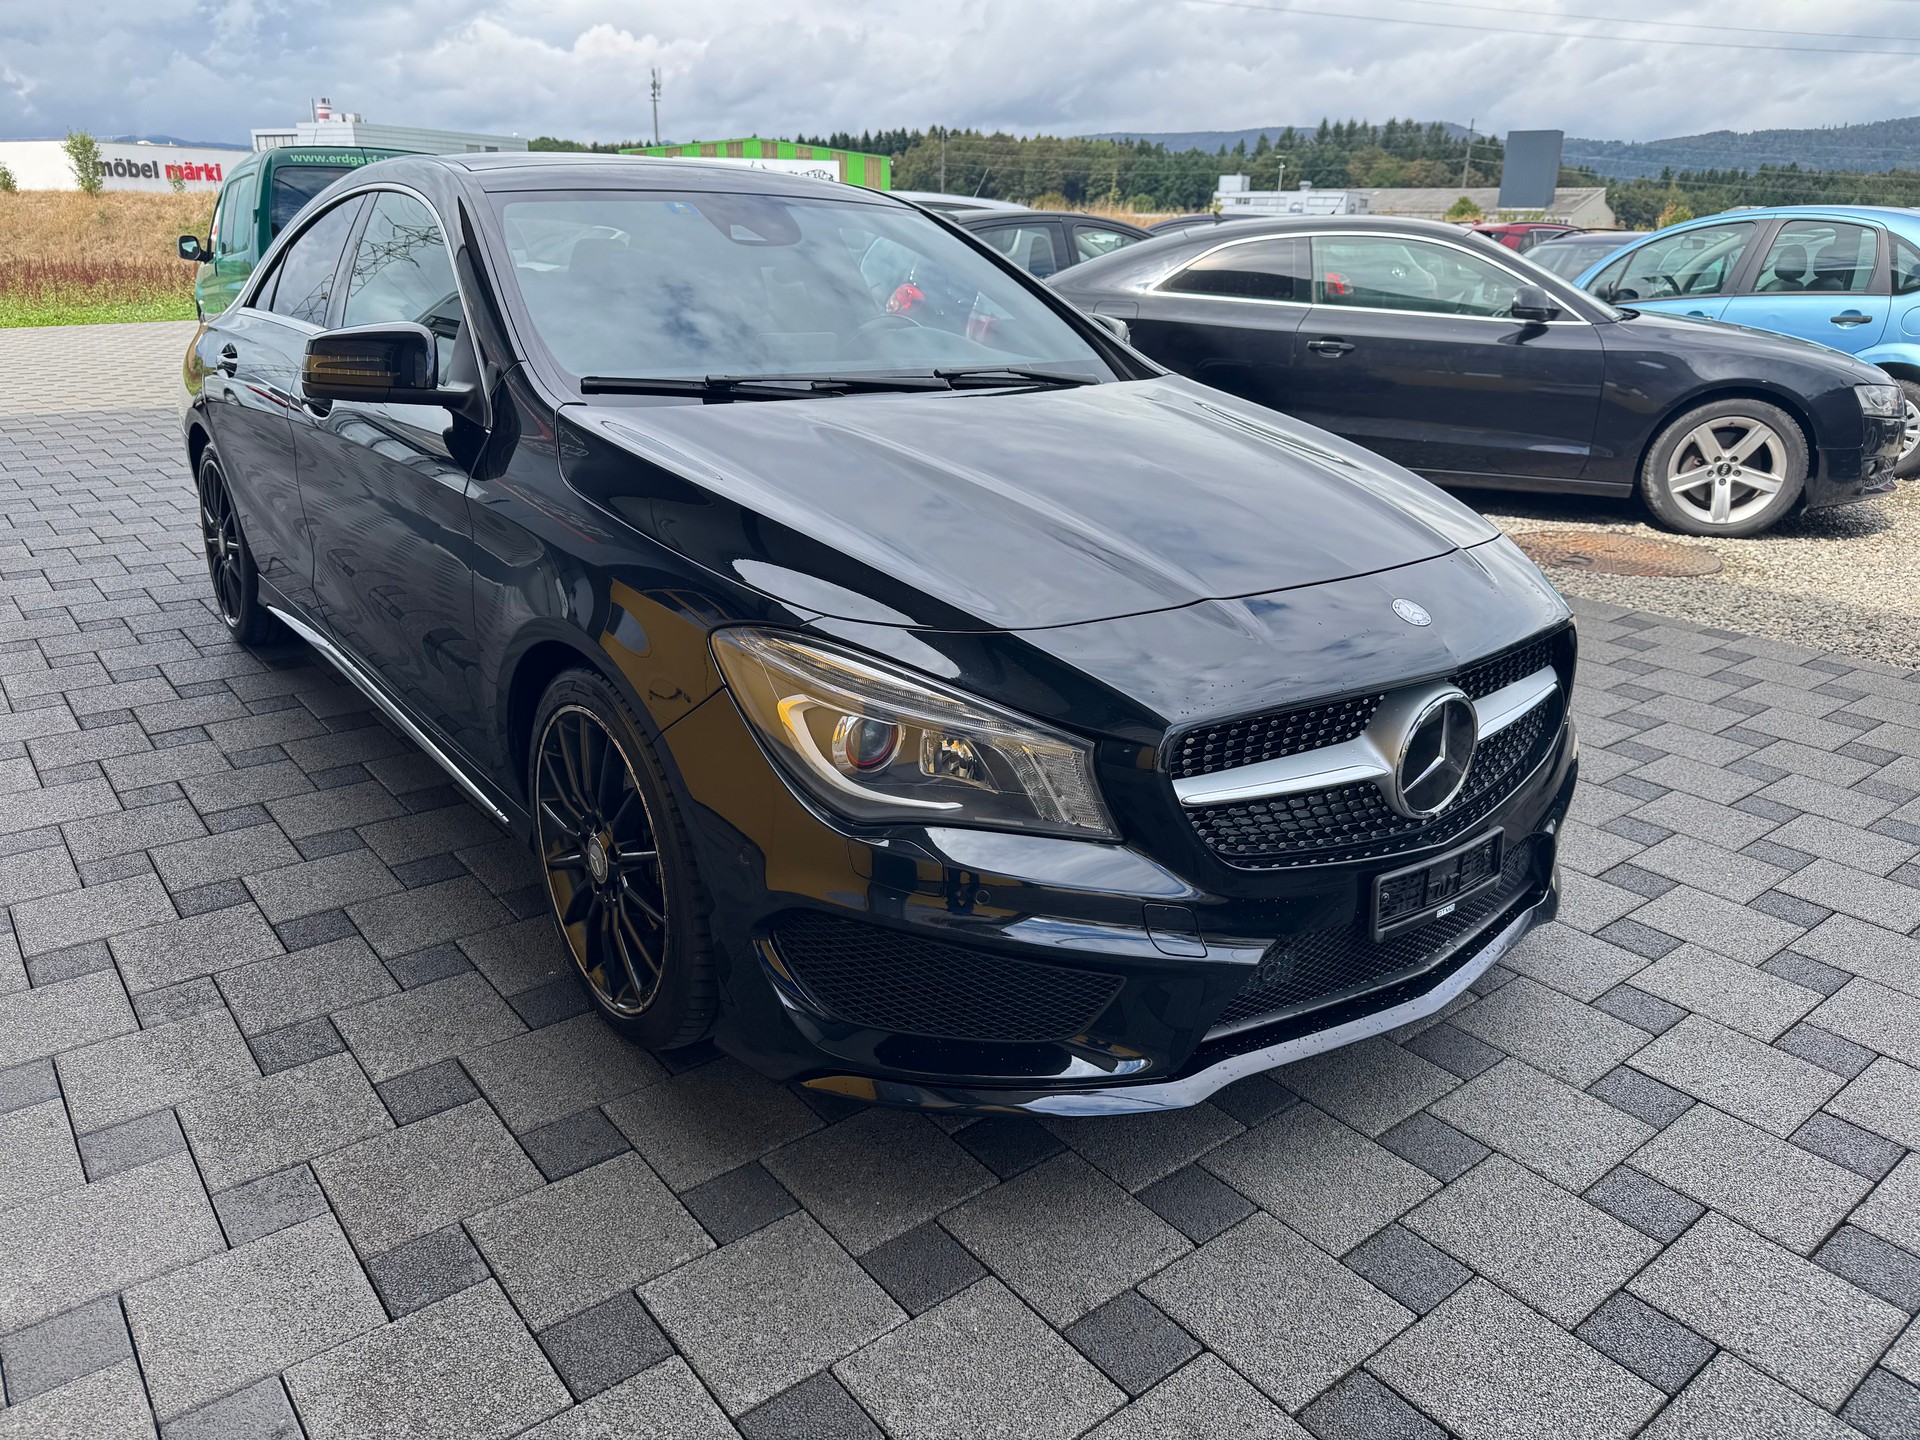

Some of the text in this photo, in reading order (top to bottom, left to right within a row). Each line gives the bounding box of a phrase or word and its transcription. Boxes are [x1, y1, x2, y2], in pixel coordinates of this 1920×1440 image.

[290, 154, 388, 166] www.erdgasf
[93, 158, 223, 181] möbel märki
